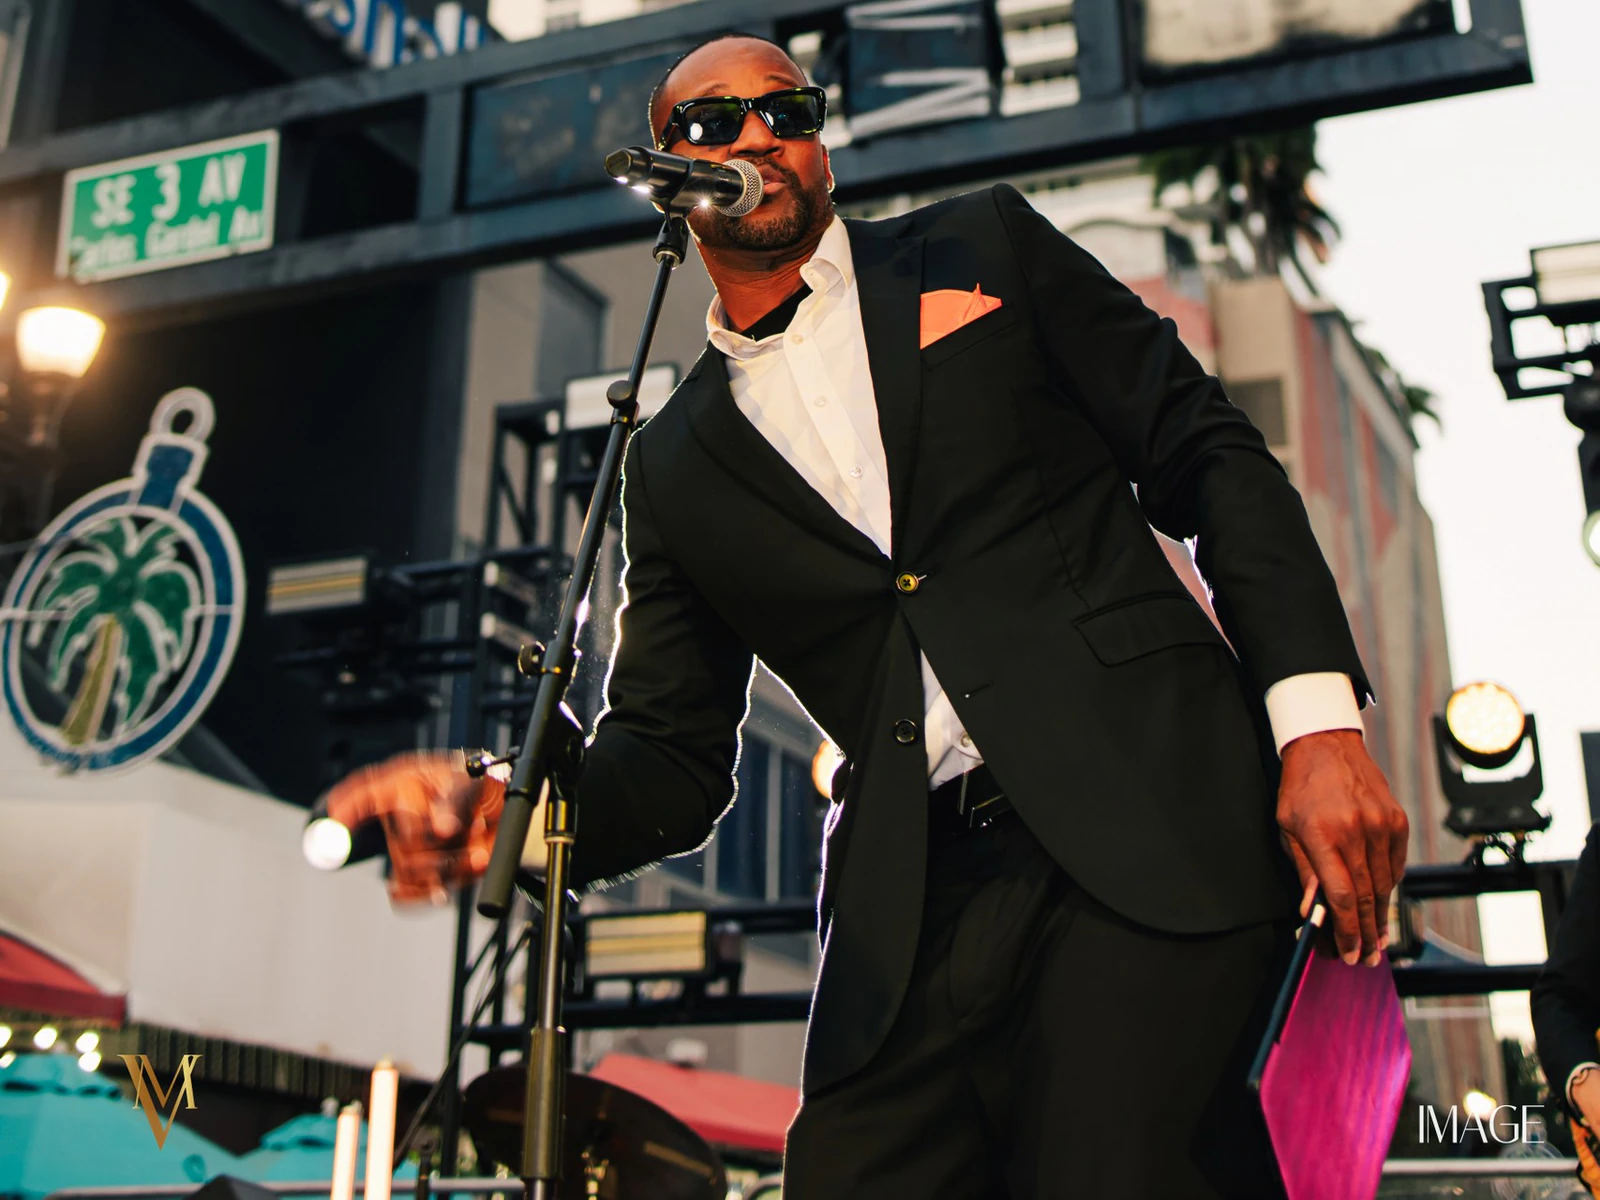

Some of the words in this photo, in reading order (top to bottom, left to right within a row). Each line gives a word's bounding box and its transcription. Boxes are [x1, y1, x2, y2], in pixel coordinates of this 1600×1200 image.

[91, 173, 136, 228] SE
[152, 161, 181, 222] 3
[198, 152, 247, 207] AV
